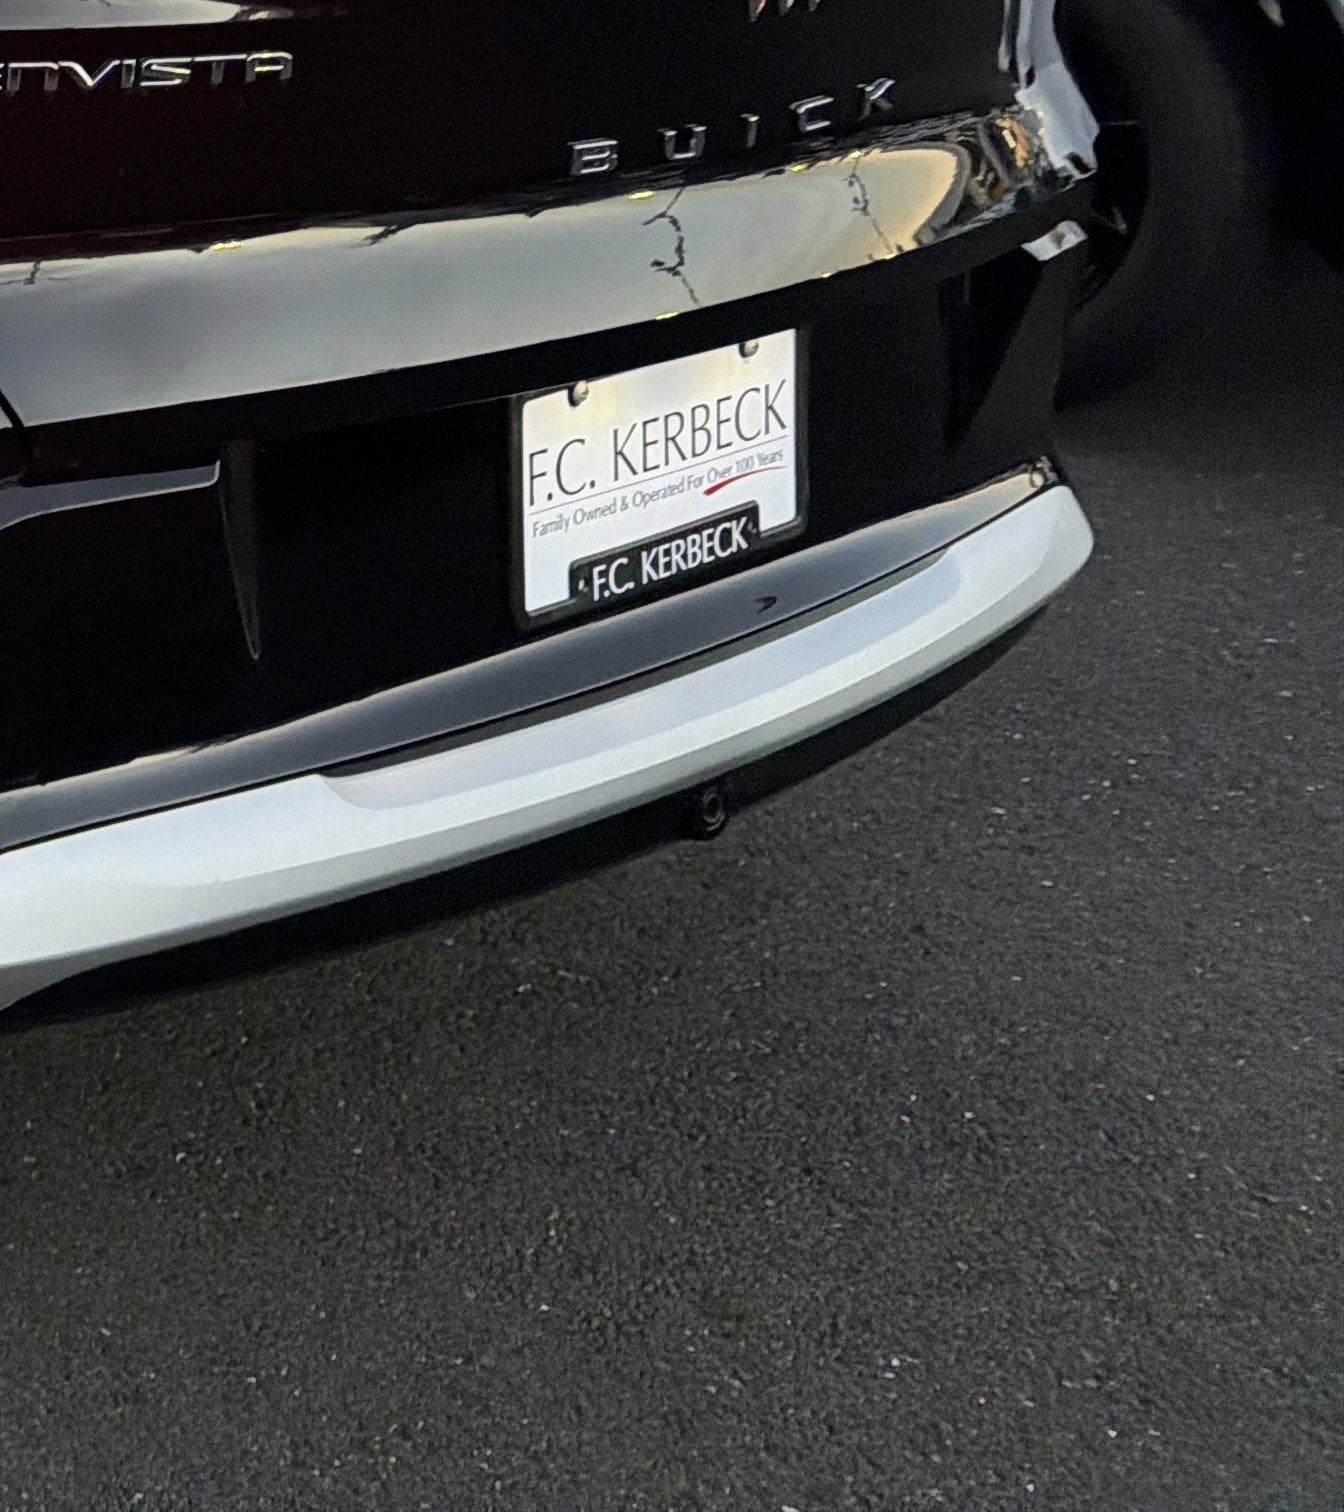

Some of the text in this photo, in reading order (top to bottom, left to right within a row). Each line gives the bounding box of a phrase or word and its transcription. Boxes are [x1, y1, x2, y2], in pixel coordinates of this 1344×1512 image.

[567, 77, 896, 176] BUICK
[528, 378, 788, 506] F.C. KERBECK
[532, 448, 784, 538] Family Owned & Operated For Over 100 Years
[592, 515, 750, 602] F.C. KERBECK
